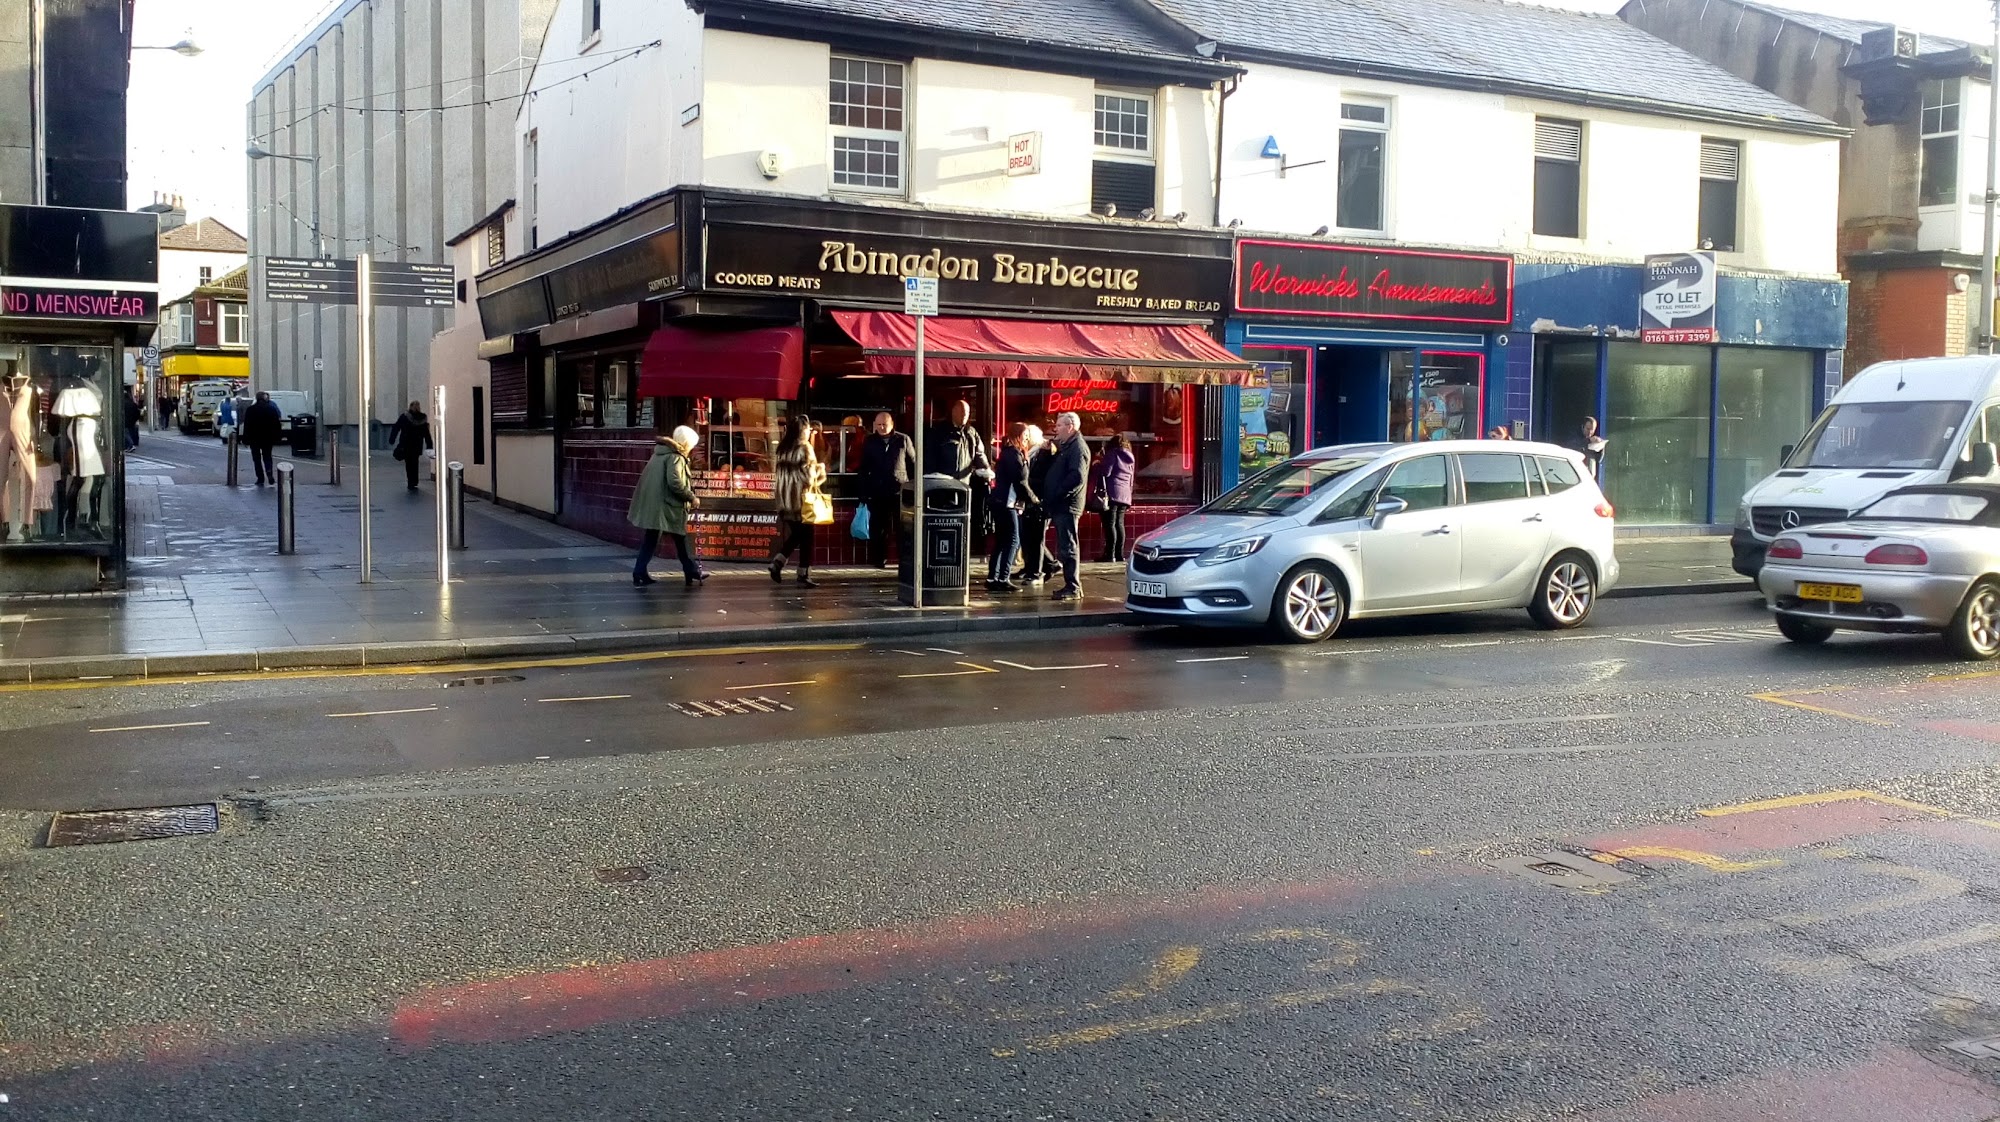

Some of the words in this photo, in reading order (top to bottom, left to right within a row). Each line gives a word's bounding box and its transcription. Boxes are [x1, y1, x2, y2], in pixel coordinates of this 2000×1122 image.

[1015, 139, 1029, 153] HOT
[1010, 155, 1032, 169] BREAD
[818, 241, 980, 283] Abingdon
[992, 253, 1139, 291] Barbecue
[1651, 266, 1698, 275] HANNAH
[714, 271, 774, 287] COOKED
[777, 275, 821, 290] MEATS
[1250, 259, 1359, 299] Warwicks
[1367, 268, 1497, 306] Amusements
[1, 292, 29, 312] ND
[35, 293, 144, 316] MENSWEAR
[1096, 295, 1142, 309] FRESHLY
[1146, 297, 1182, 310] BAKED
[1185, 301, 1221, 312] BREAD
[1656, 292, 1674, 304] TO
[1679, 291, 1702, 303] LET
[1048, 391, 1118, 413] Barbecue
[737, 515, 751, 523] HOT
[753, 515, 778, 523] BARM!
[686, 525, 724, 534] BACON,
[728, 526, 780, 536] SAUSAGE,
[709, 536, 730, 545] HOT
[734, 537, 771, 546] ROAST
[695, 547, 724, 556] PORK
[741, 549, 770, 557] BEEF
[1134, 583, 1147, 593] PJ17
[1149, 584, 1162, 594] YDG
